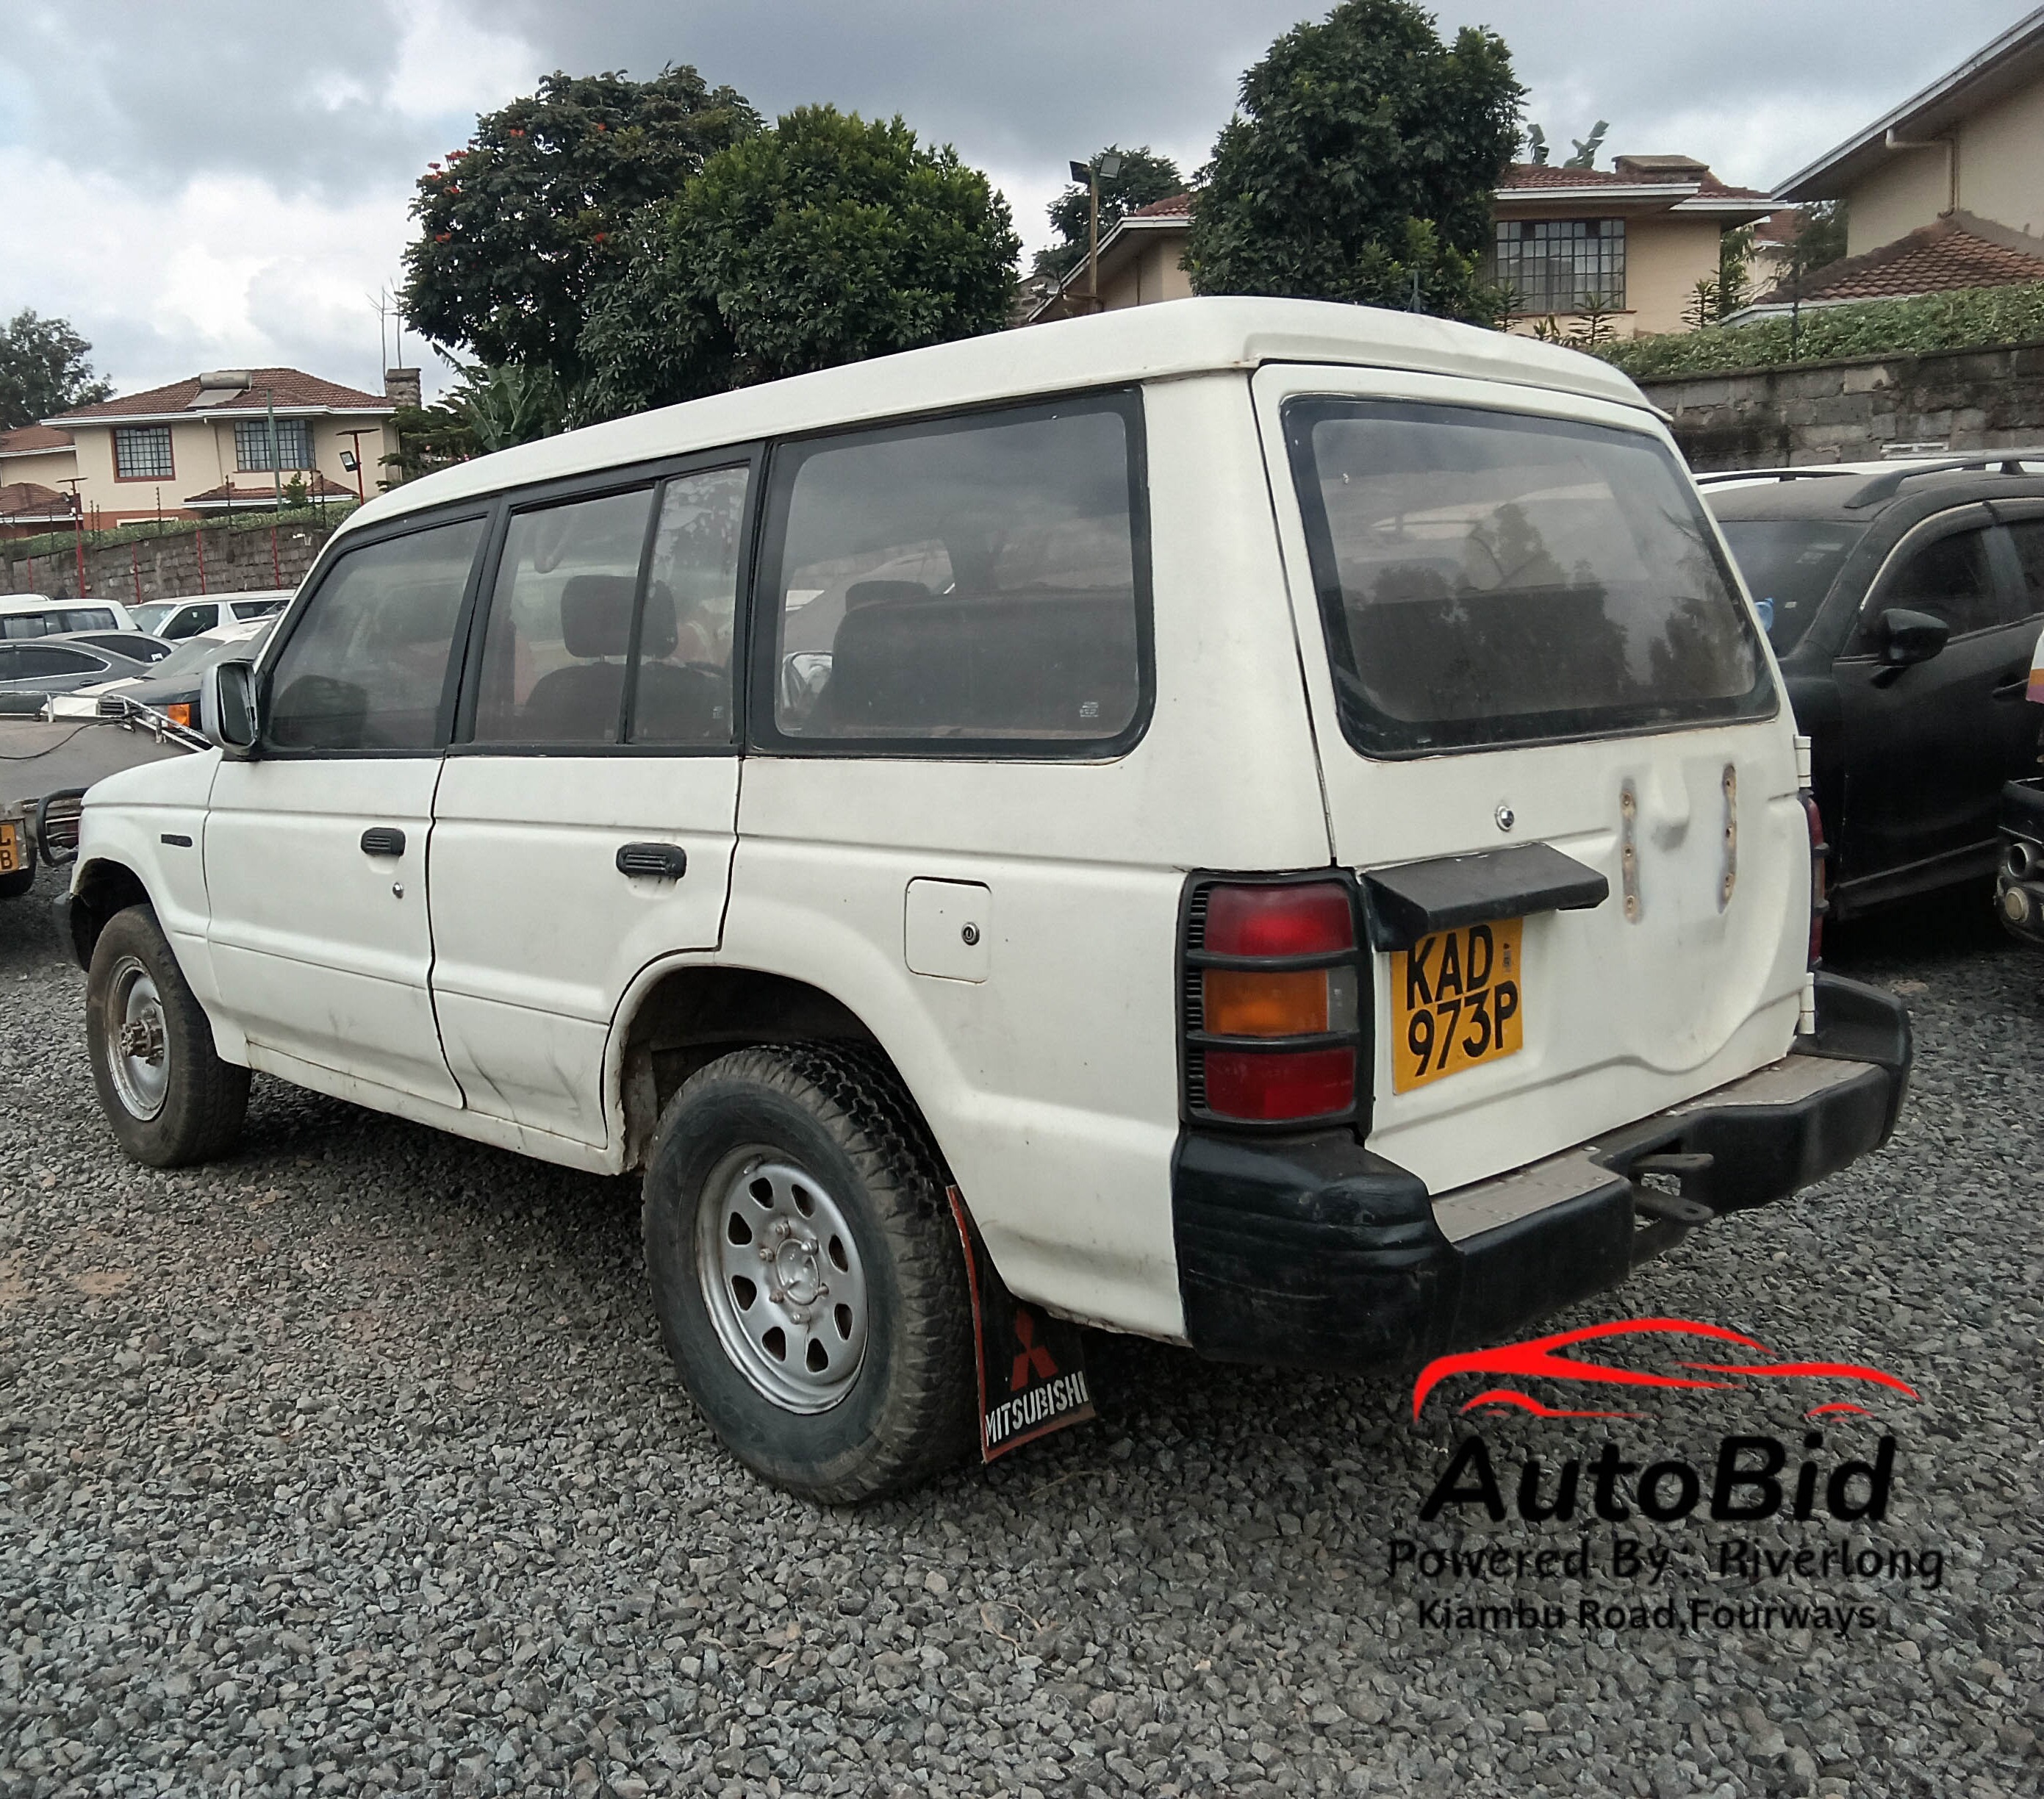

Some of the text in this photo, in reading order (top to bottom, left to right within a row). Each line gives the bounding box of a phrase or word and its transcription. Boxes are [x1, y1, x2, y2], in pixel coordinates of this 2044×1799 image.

[1407, 924, 1493, 1010] KAD
[1408, 980, 1518, 1077] 973P
[985, 1371, 1089, 1446] MITSUBISHI
